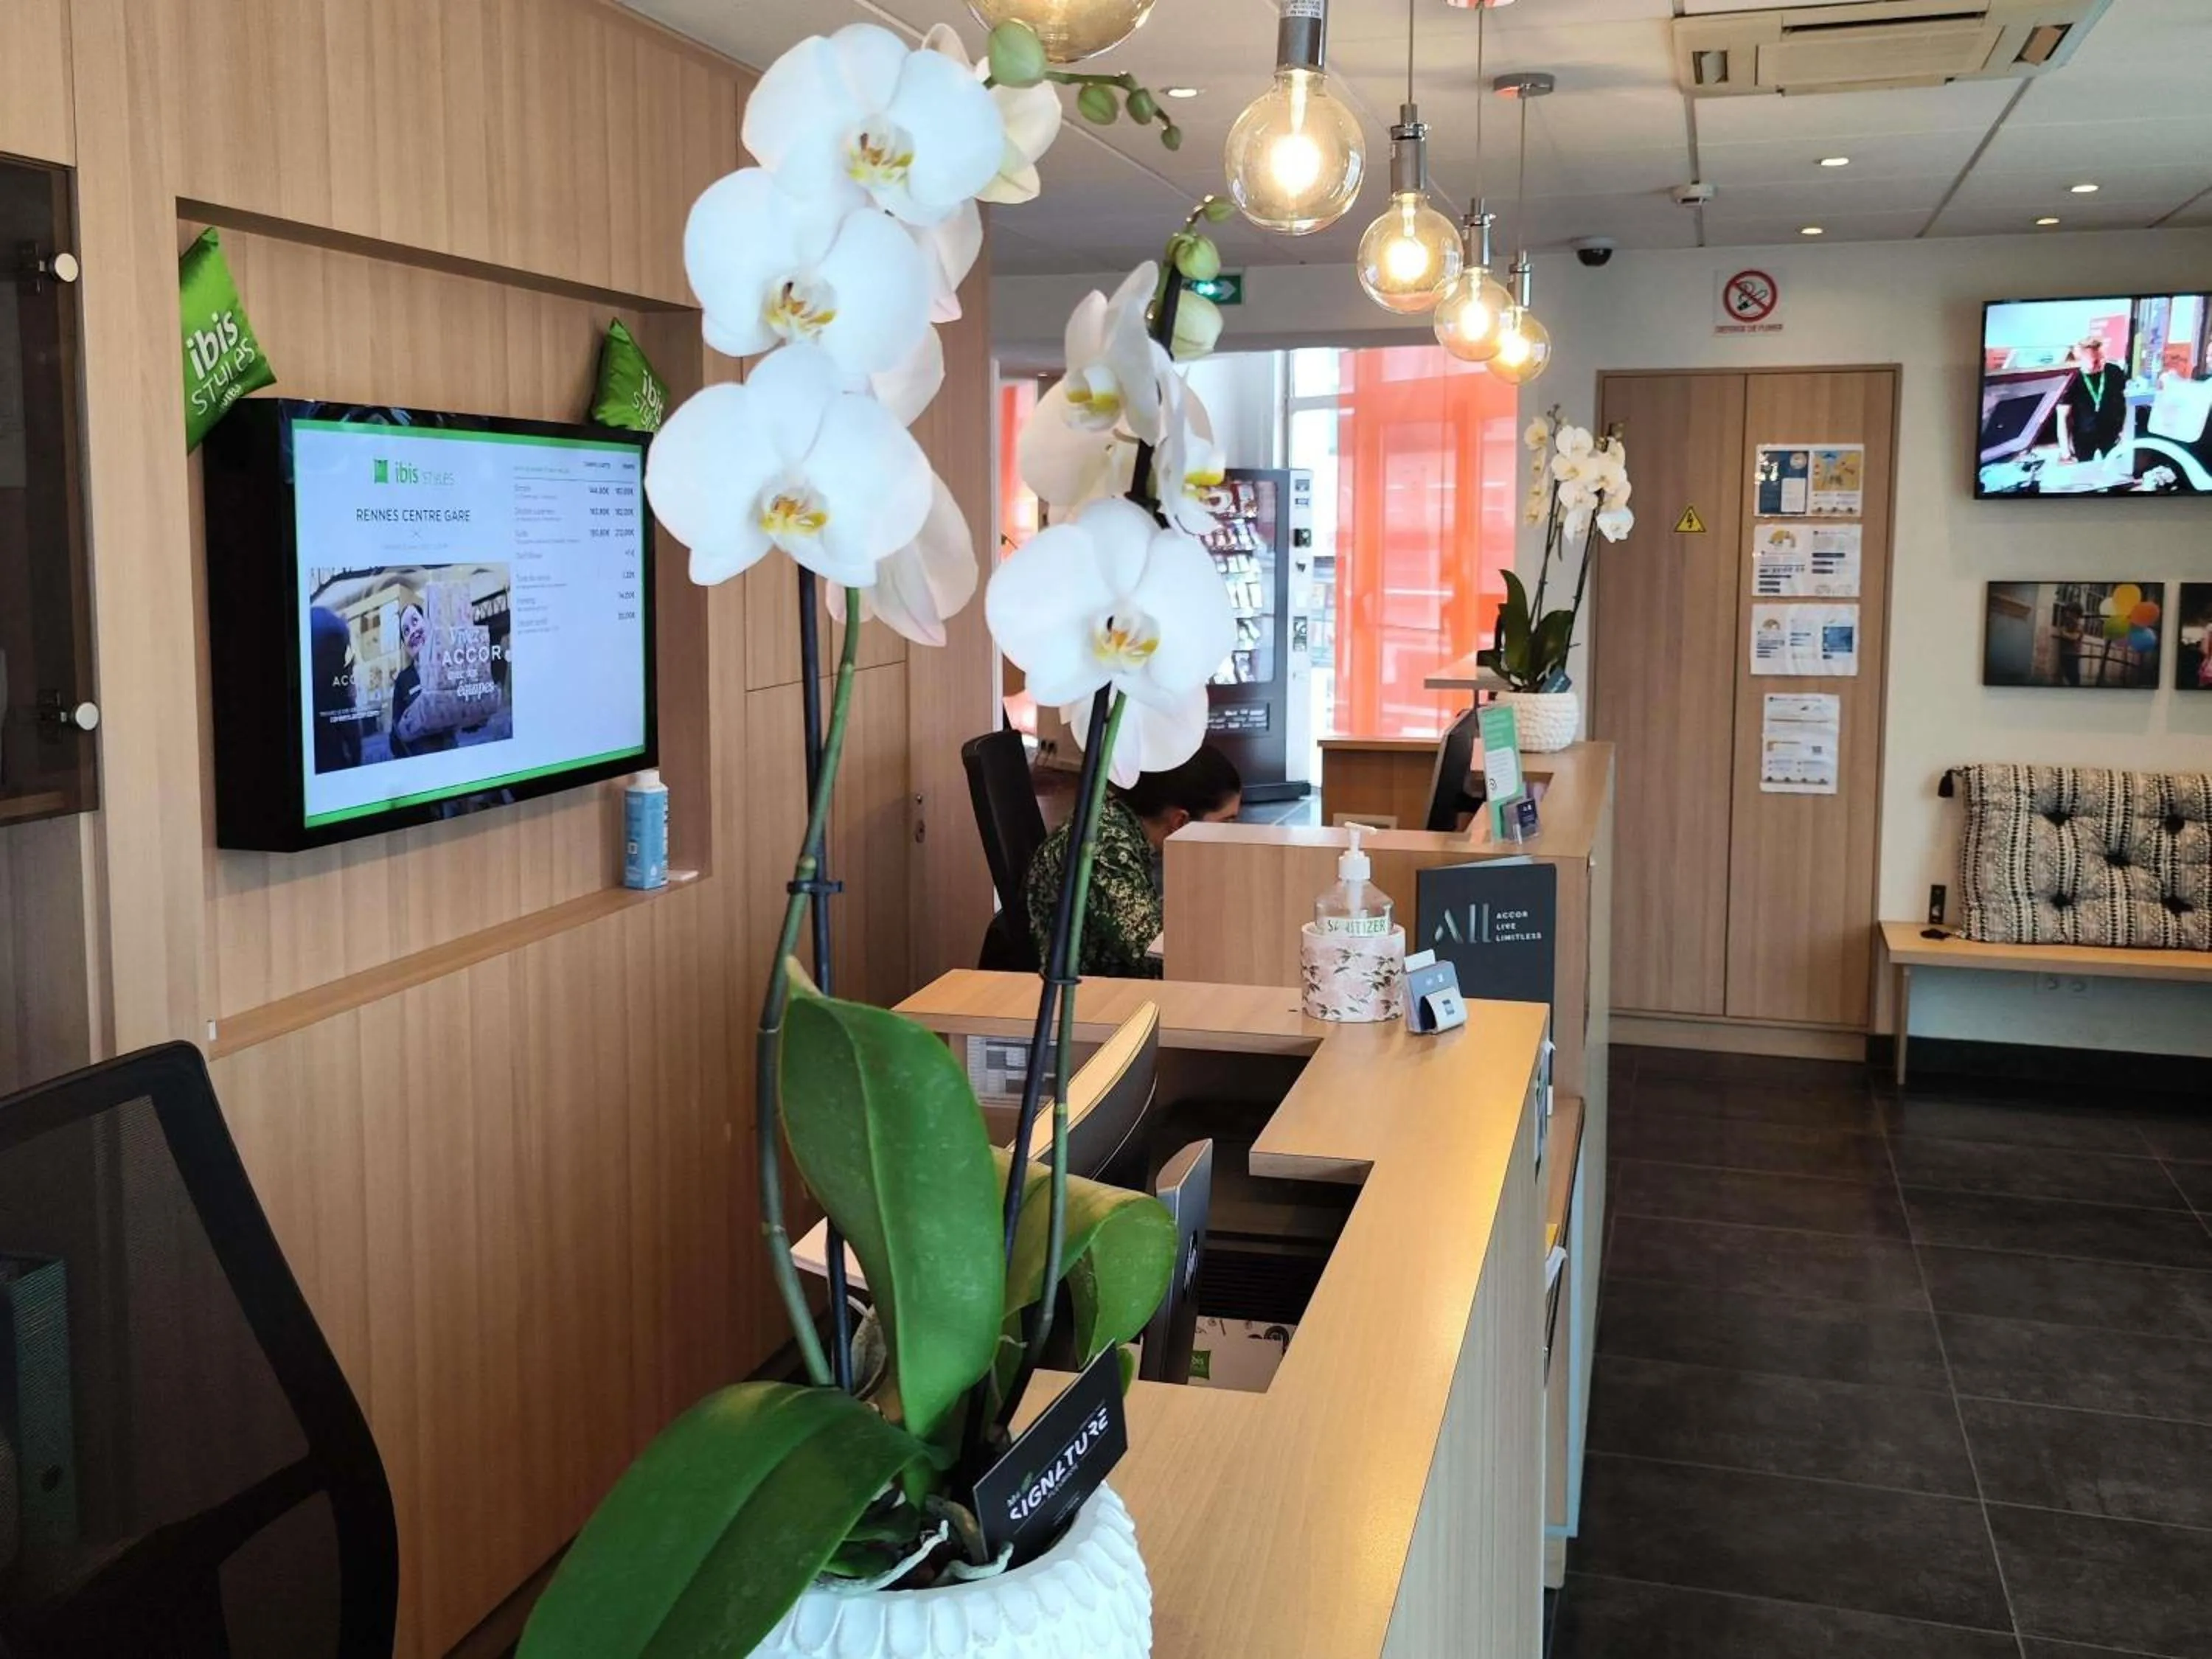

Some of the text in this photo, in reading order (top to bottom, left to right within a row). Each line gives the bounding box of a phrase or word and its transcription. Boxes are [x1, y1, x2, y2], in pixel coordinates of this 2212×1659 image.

[187, 310, 238, 380] ibis
[394, 462, 420, 484] ibis
[356, 508, 470, 522] RENNES CENTRE GARE
[442, 645, 501, 667] ACCOR
[1496, 911, 1528, 920] ACCOR
[1328, 919, 1386, 934] SITIZER
[1496, 922, 1516, 931] LIVE
[1495, 932, 1542, 942] LIMITLESS
[1008, 1406, 1109, 1520] SIGNATURE
